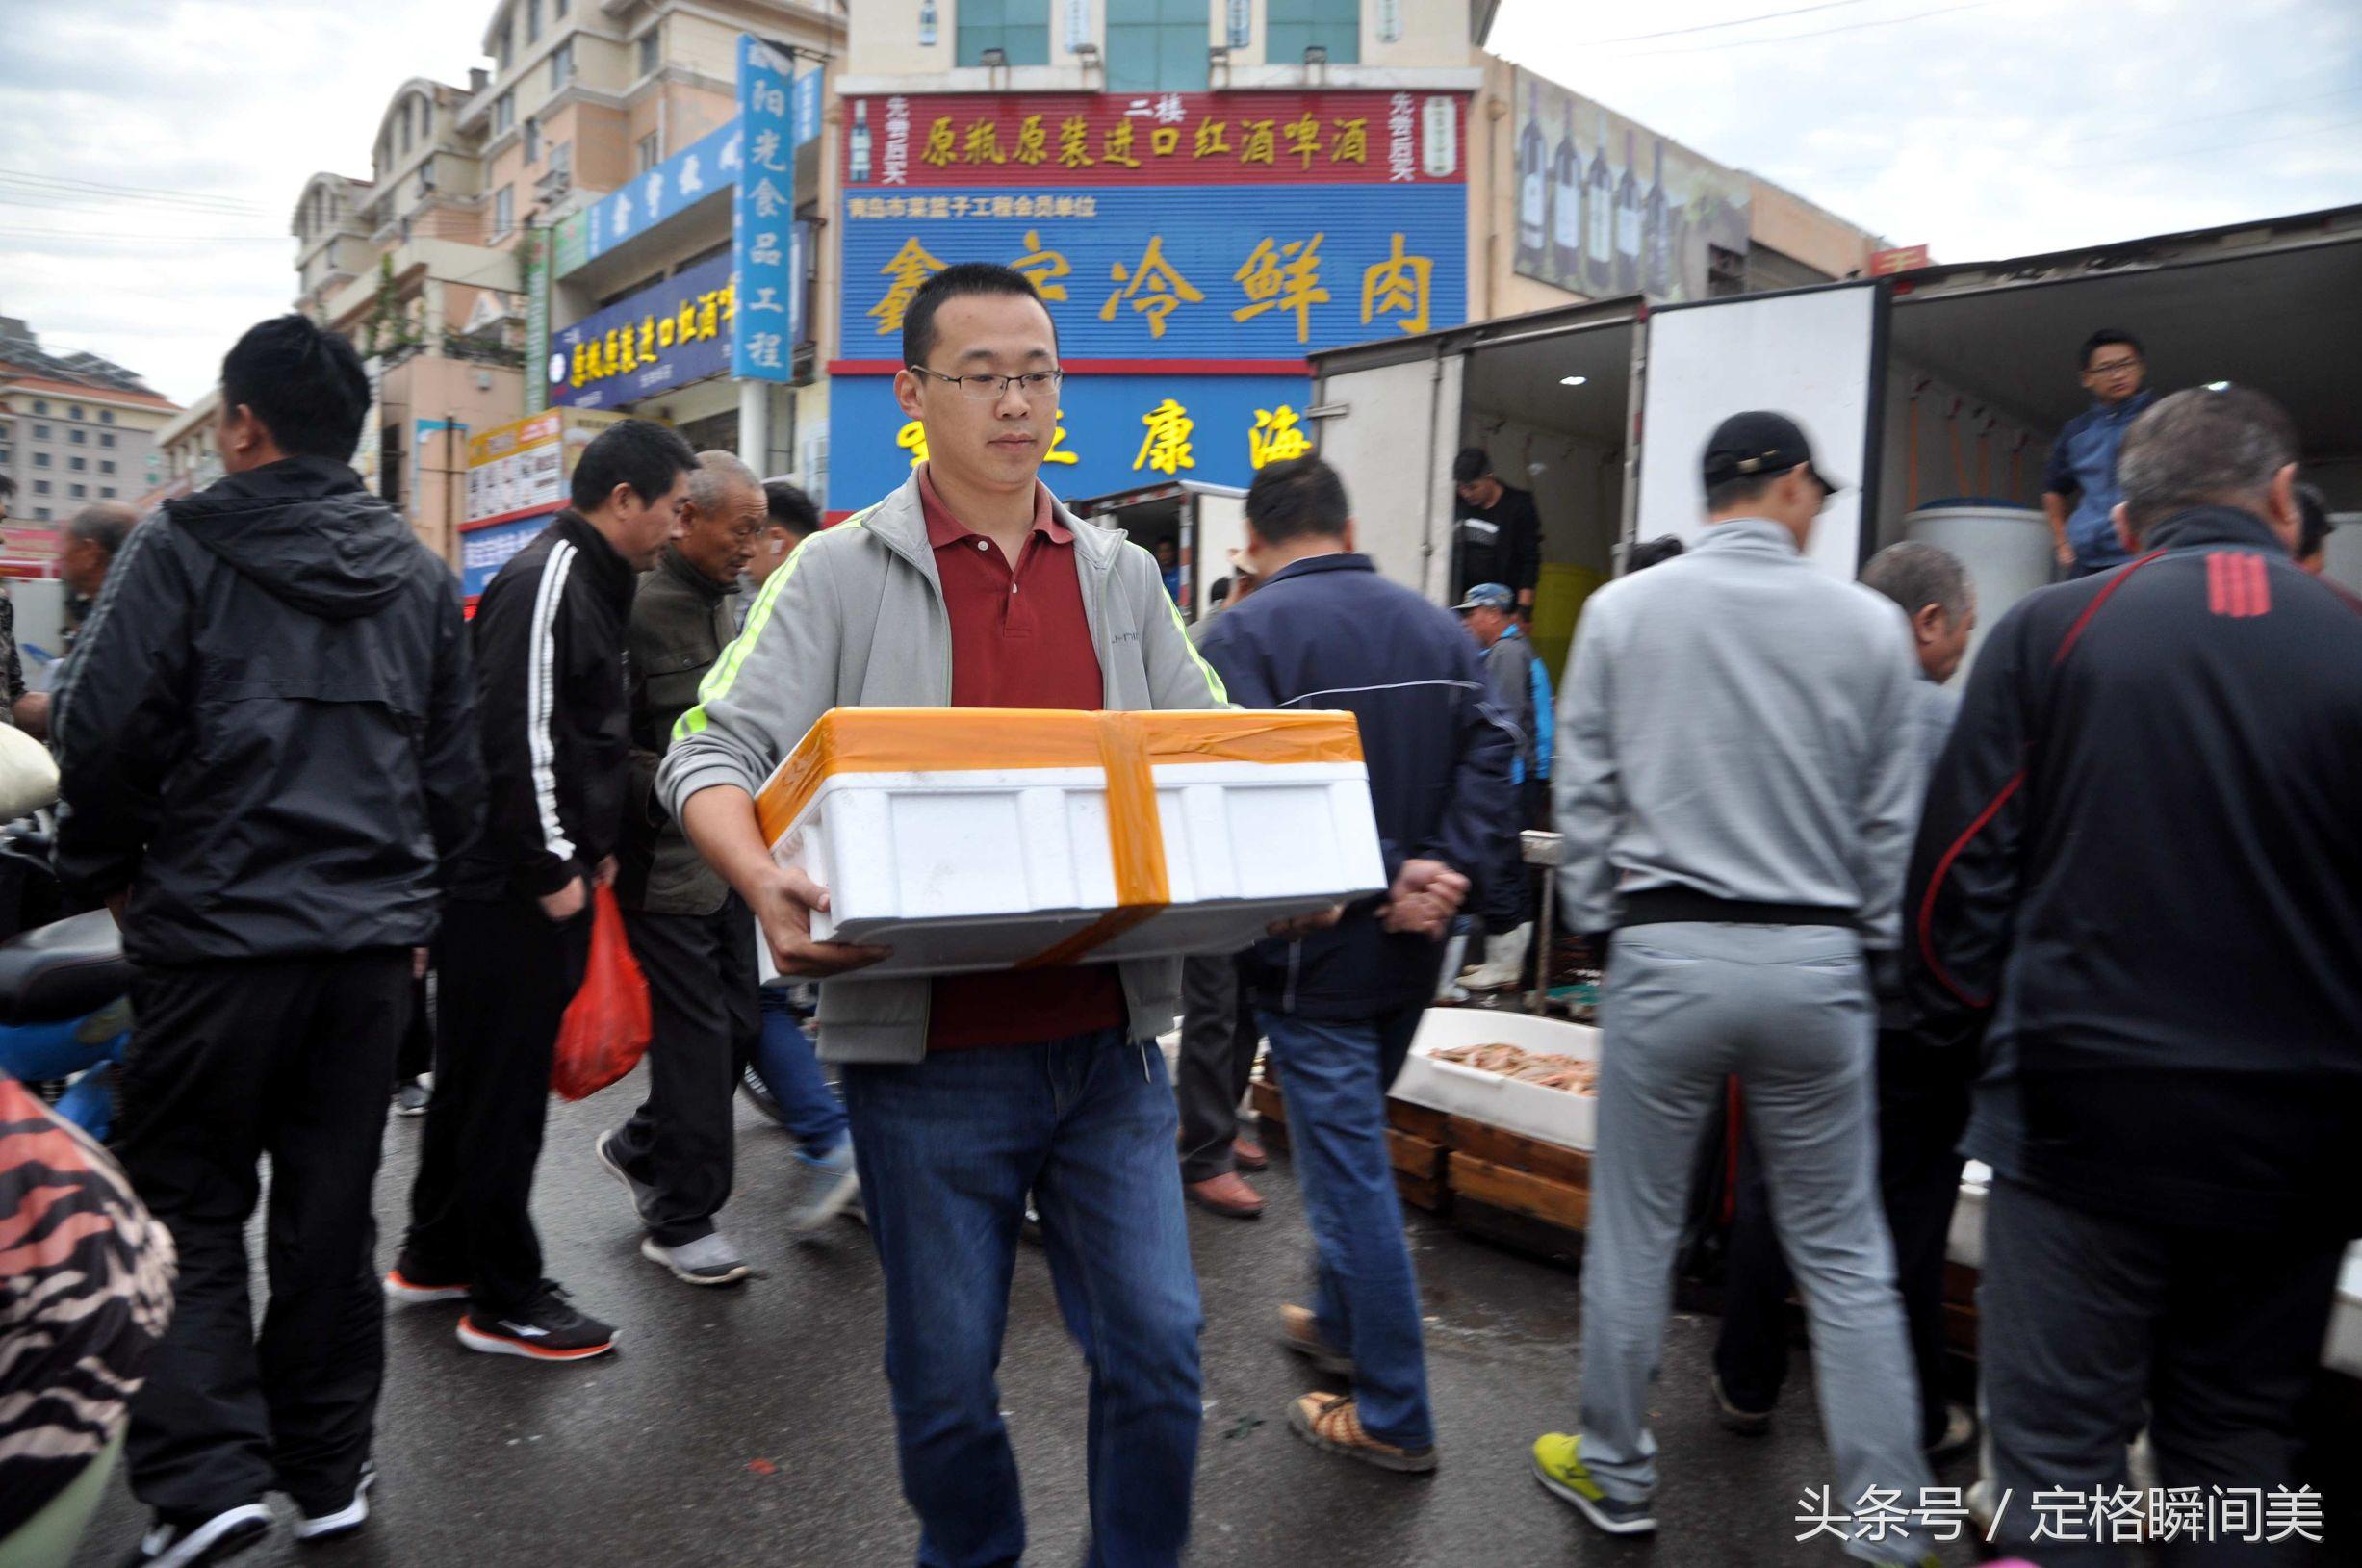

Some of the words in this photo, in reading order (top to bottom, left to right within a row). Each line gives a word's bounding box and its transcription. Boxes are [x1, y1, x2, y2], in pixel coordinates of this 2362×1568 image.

[1123, 92, 1188, 124] 二楼
[920, 111, 1368, 171] 原瓶原装进口红酒啤酒
